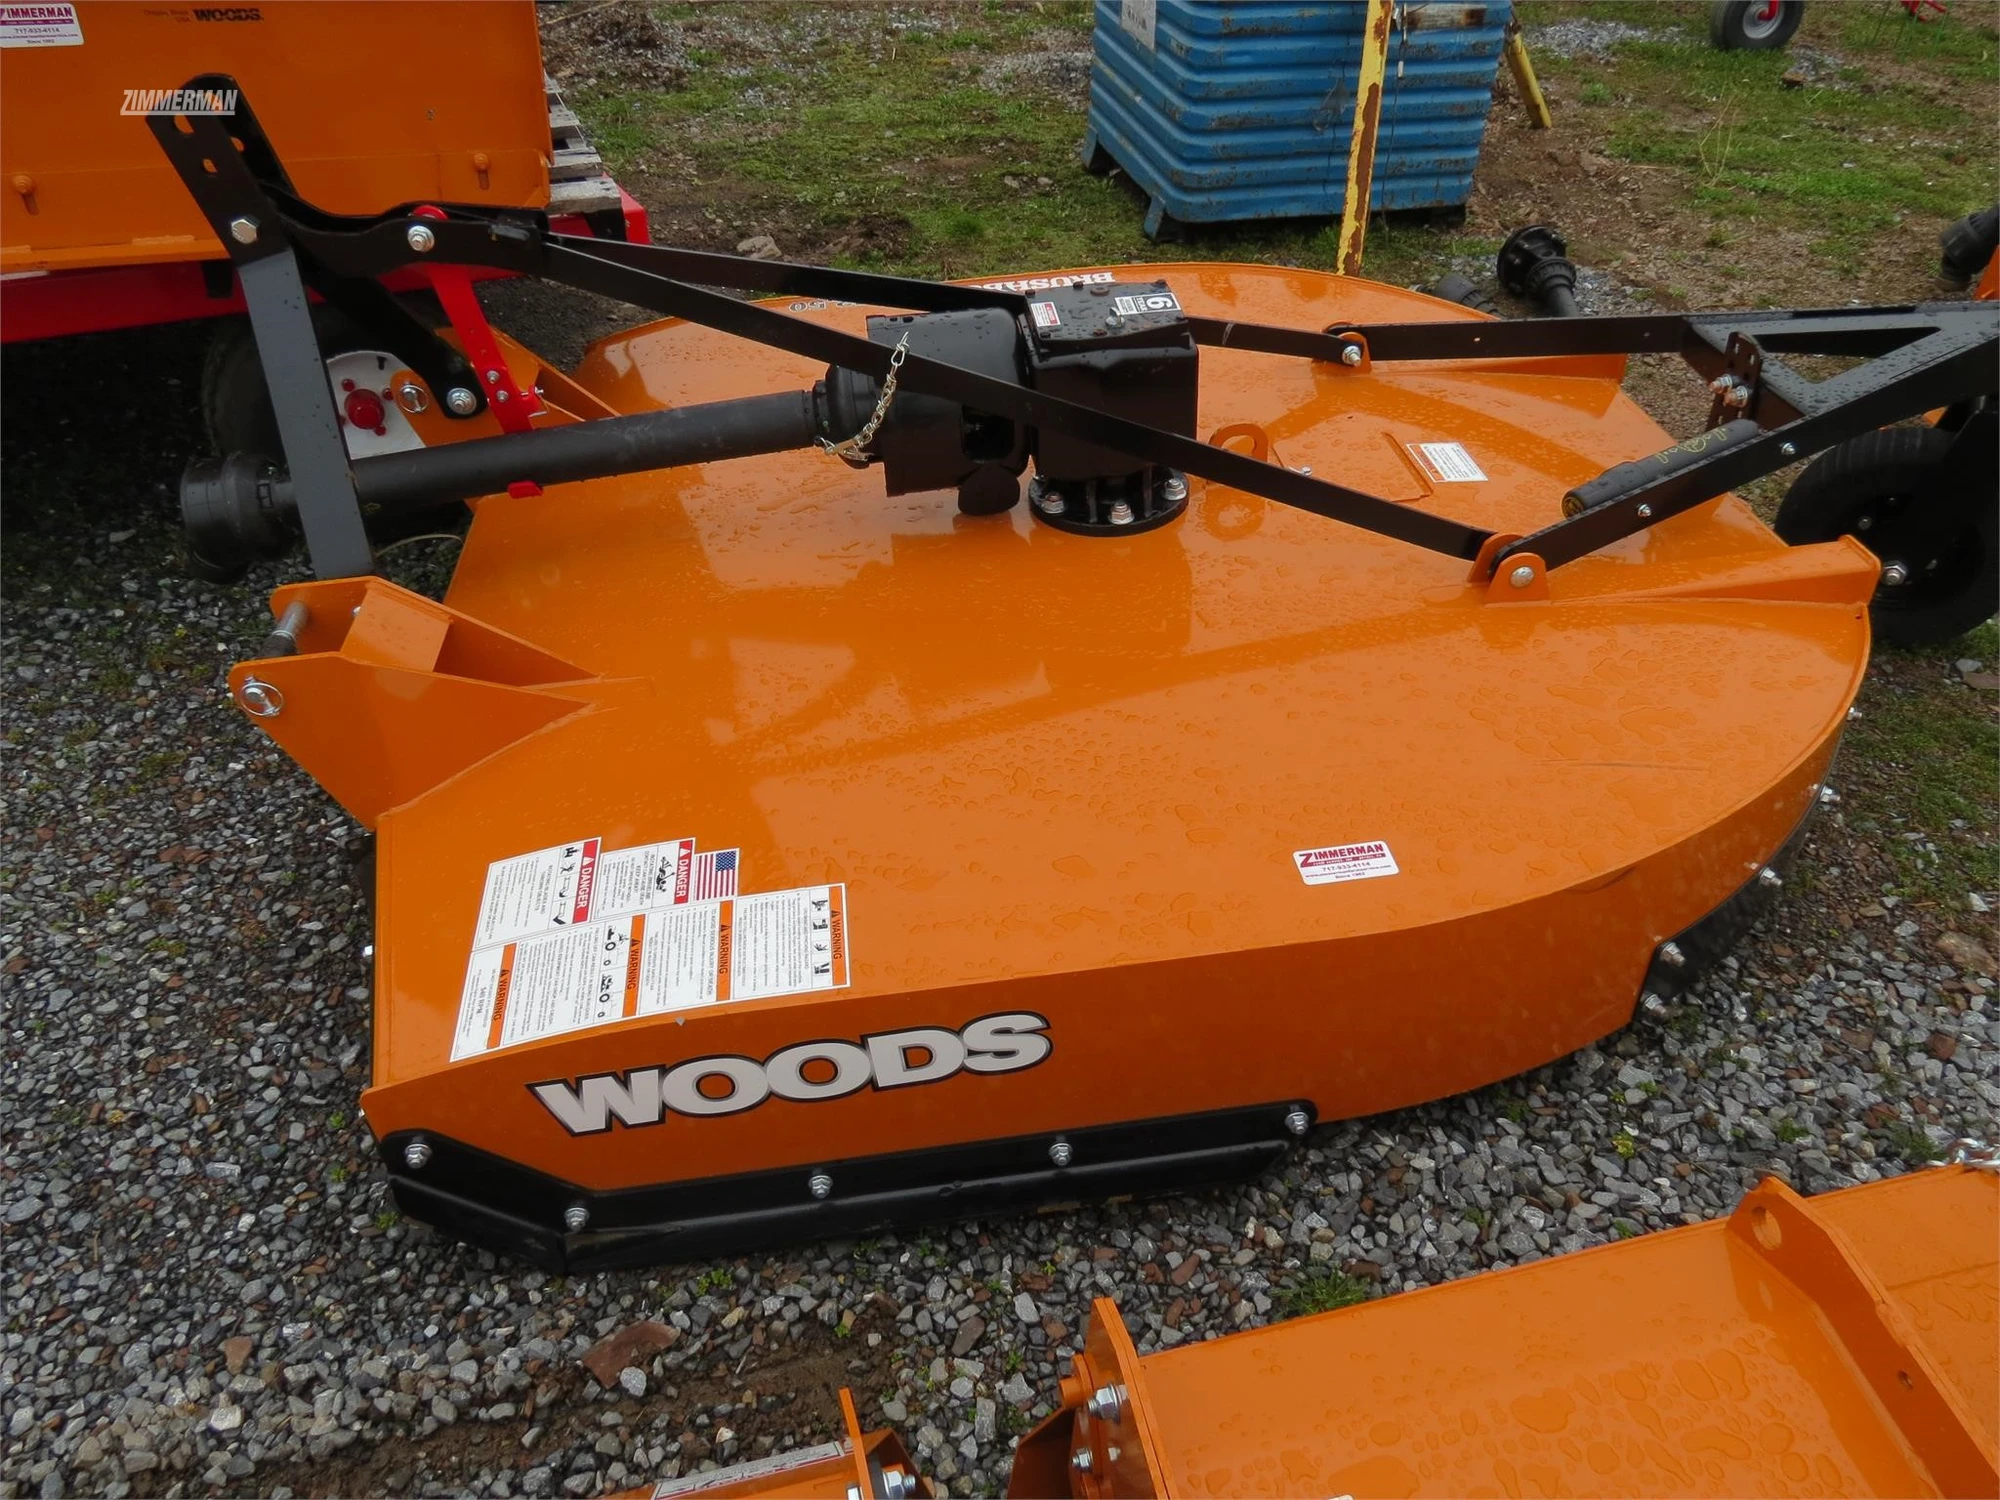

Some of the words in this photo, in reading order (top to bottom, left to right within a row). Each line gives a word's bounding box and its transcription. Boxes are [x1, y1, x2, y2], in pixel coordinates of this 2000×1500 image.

[193, 8, 264, 21] WOODS
[1146, 297, 1173, 309] 6
[1299, 844, 1384, 868] ZIMMERMAN
[575, 866, 592, 909] DANGER
[675, 858, 688, 897] DANGER
[719, 933, 729, 974] WARNING
[831, 918, 842, 959] WARNING
[626, 947, 639, 990] WARNING
[492, 977, 507, 1022] WARNING
[523, 1011, 1053, 1137] WOODS
